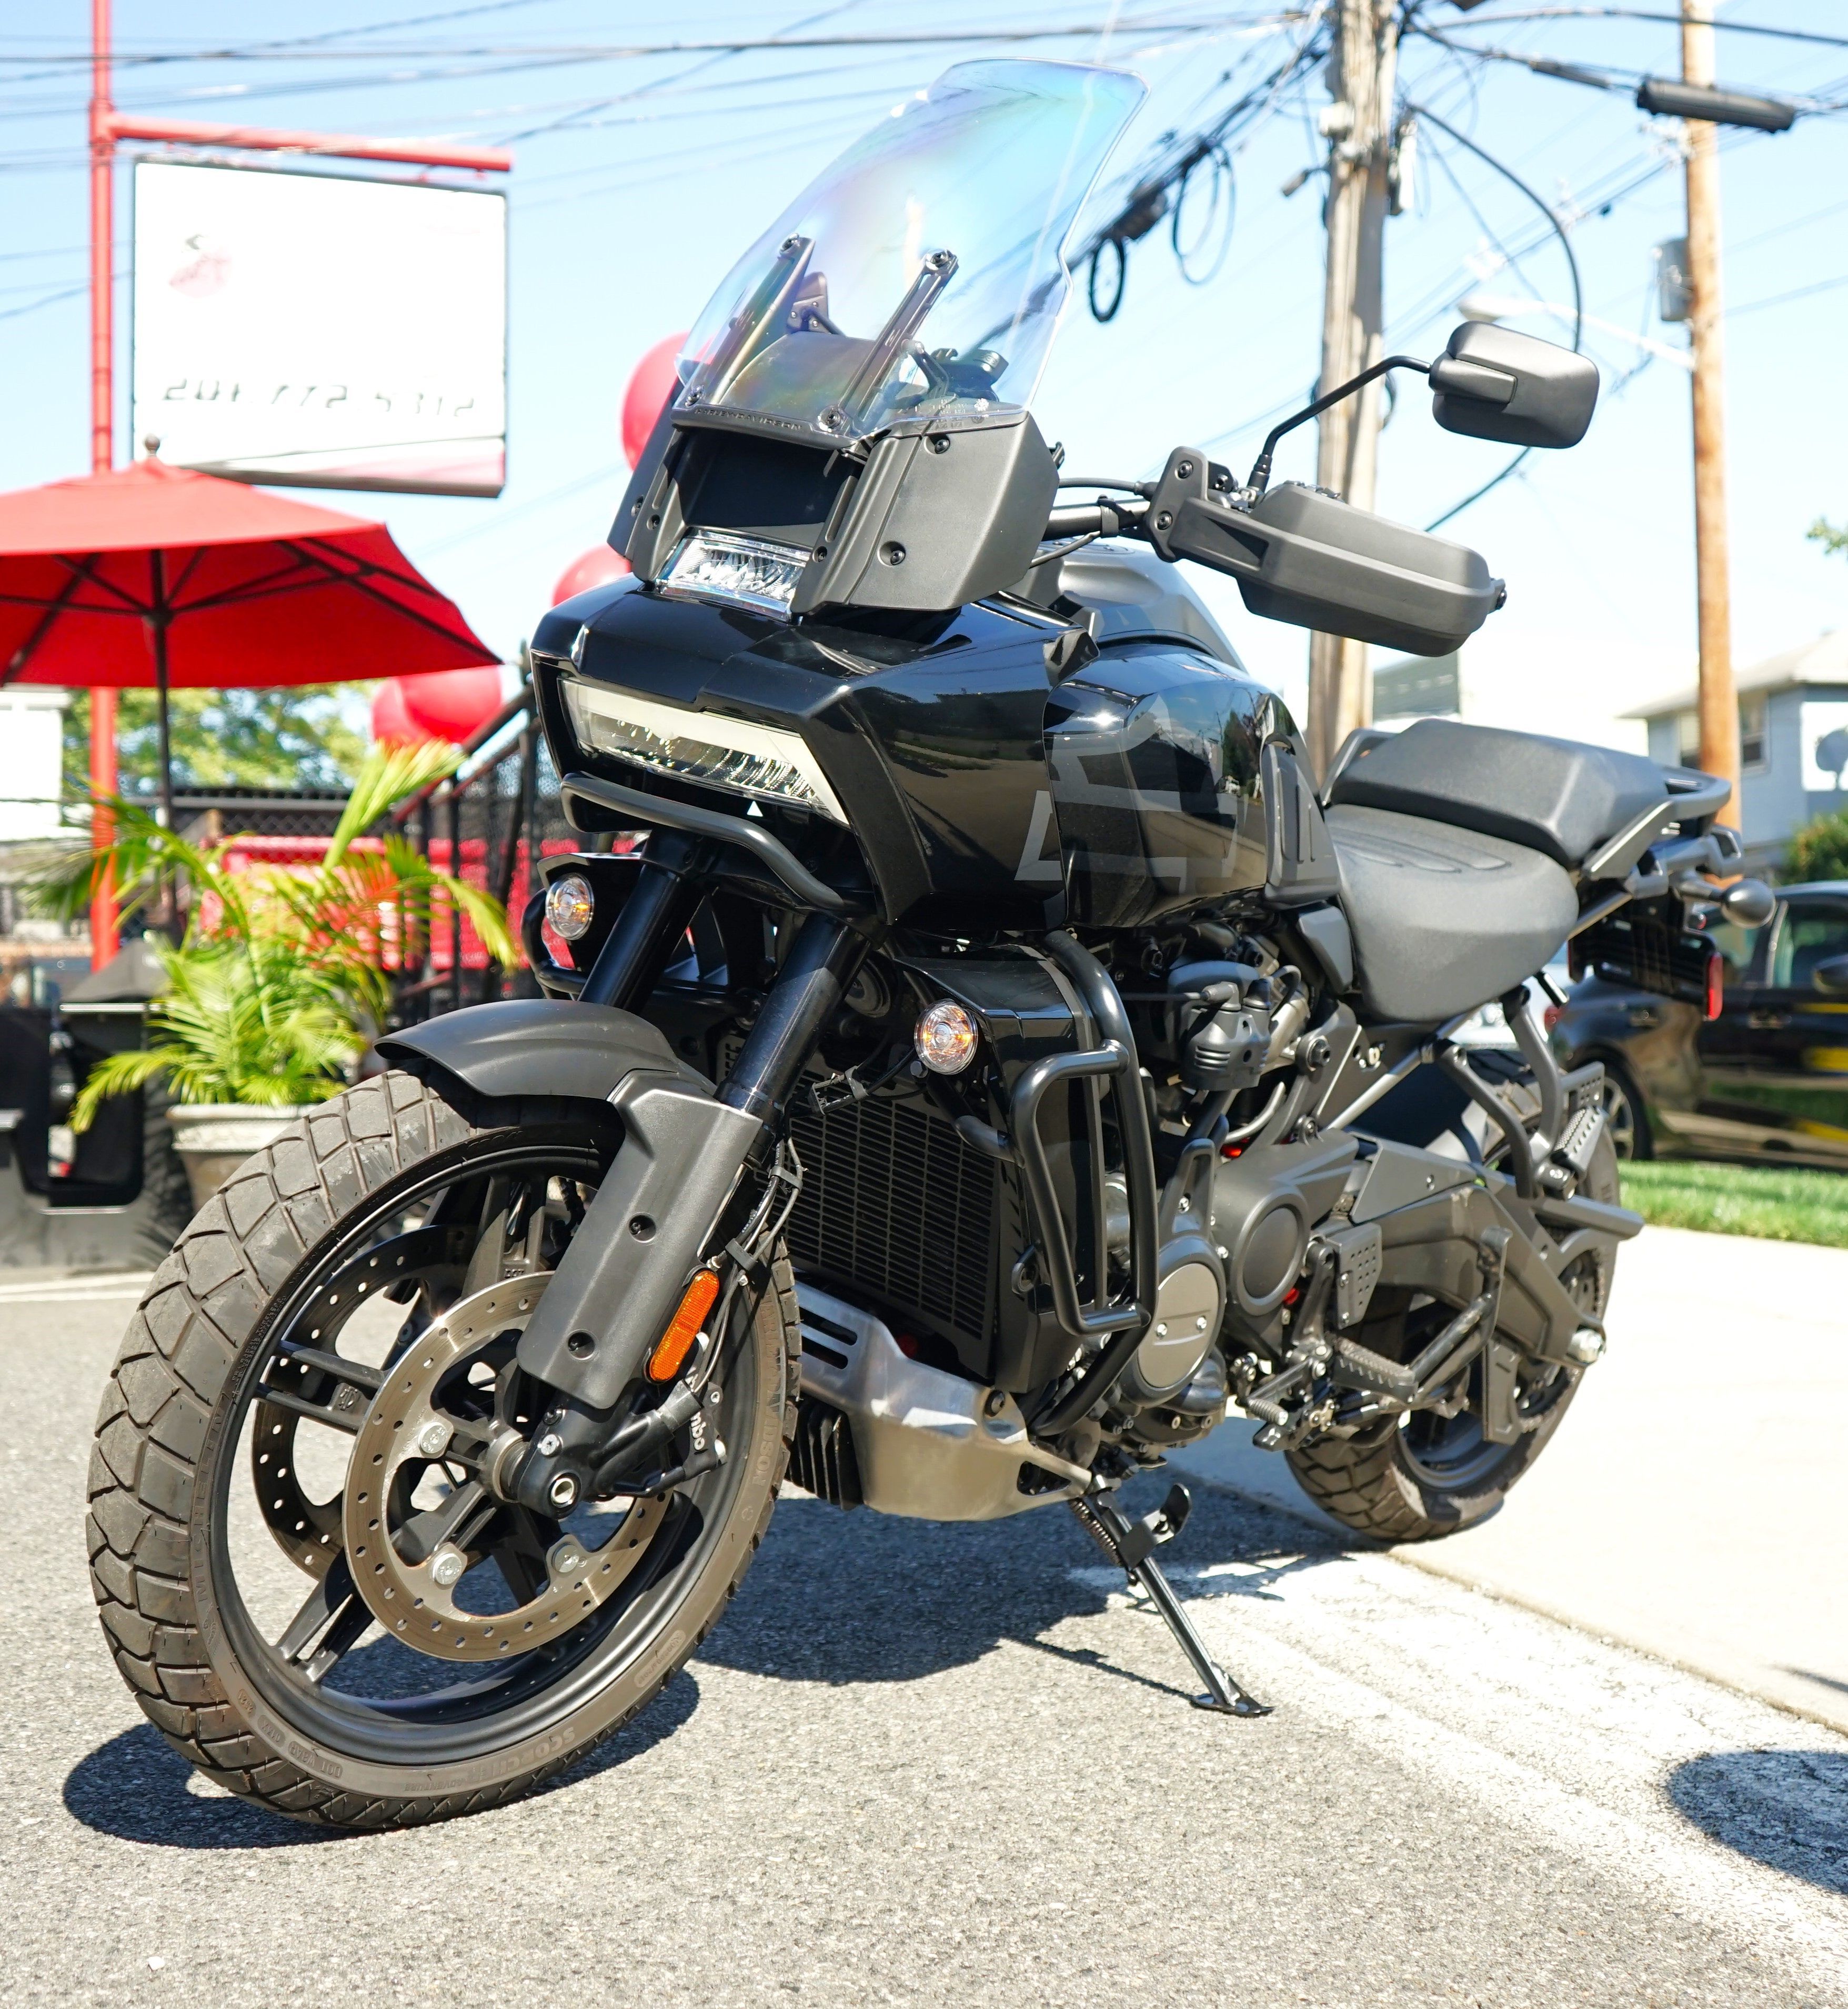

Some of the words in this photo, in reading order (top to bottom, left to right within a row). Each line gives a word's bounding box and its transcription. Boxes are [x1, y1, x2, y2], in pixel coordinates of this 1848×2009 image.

[695, 408, 802, 430] HARLEY-DAVIDSON
[690, 1412, 706, 1451] mbo
[192, 1411, 223, 1602] MICHELIN
[319, 1760, 342, 1778] DOT
[466, 1725, 579, 1784] SCORCHER
[404, 1777, 466, 1791] ADVENTURE
